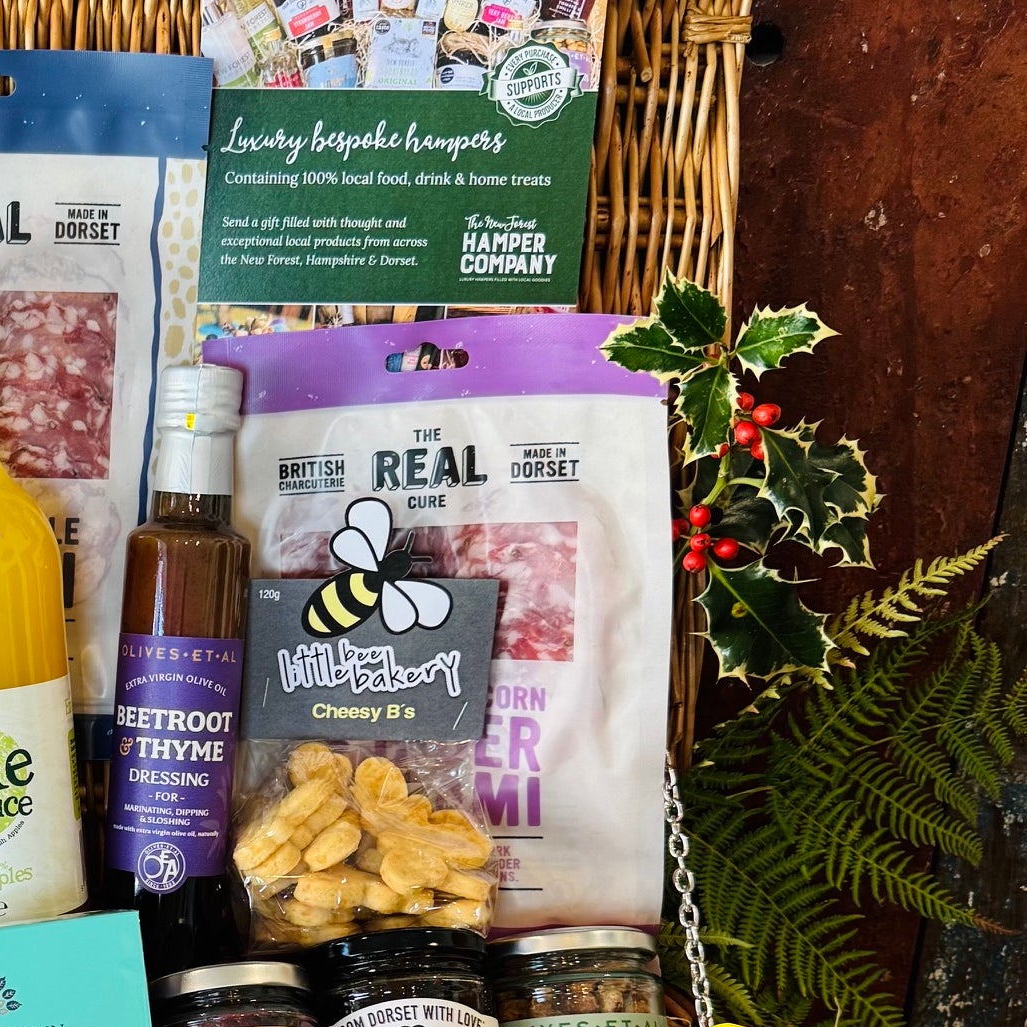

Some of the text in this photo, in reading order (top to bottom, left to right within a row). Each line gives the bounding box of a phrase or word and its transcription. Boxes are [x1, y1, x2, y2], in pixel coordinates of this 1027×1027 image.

[508, 49, 557, 72] EVERY PURCHASE
[506, 72, 561, 96] SUPPORTS
[514, 108, 533, 118] LOCAL
[534, 94, 563, 118] PRODUCER
[220, 116, 506, 164] Luxury bespoke hampers
[225, 171, 551, 188] Containing 100% local food, drink & home treats
[55, 222, 120, 240] DORSET
[222, 217, 406, 231] Send a gift filled with thought and
[221, 235, 428, 250] exceptional local products from across
[462, 232, 545, 253] HAMPER
[220, 255, 418, 268] the New Forest, Hampshire & Dorset.
[459, 254, 557, 275] COMPANY
[413, 428, 441, 442] THE
[523, 448, 566, 459] MADE IN
[279, 459, 345, 480] BRITISH
[373, 445, 488, 492] REAL
[511, 460, 580, 479] DORSET
[279, 477, 345, 492] CHARCUTERIE
[407, 494, 446, 510] CURE
[258, 590, 280, 600] 120g
[117, 705, 233, 733] BEETROOT
[312, 704, 381, 722] Cheesy
[119, 737, 224, 762] & THYME
[129, 768, 210, 786] DRESSING
[367, 1005, 418, 1027] DORSET
[423, 1005, 453, 1022] WITH
